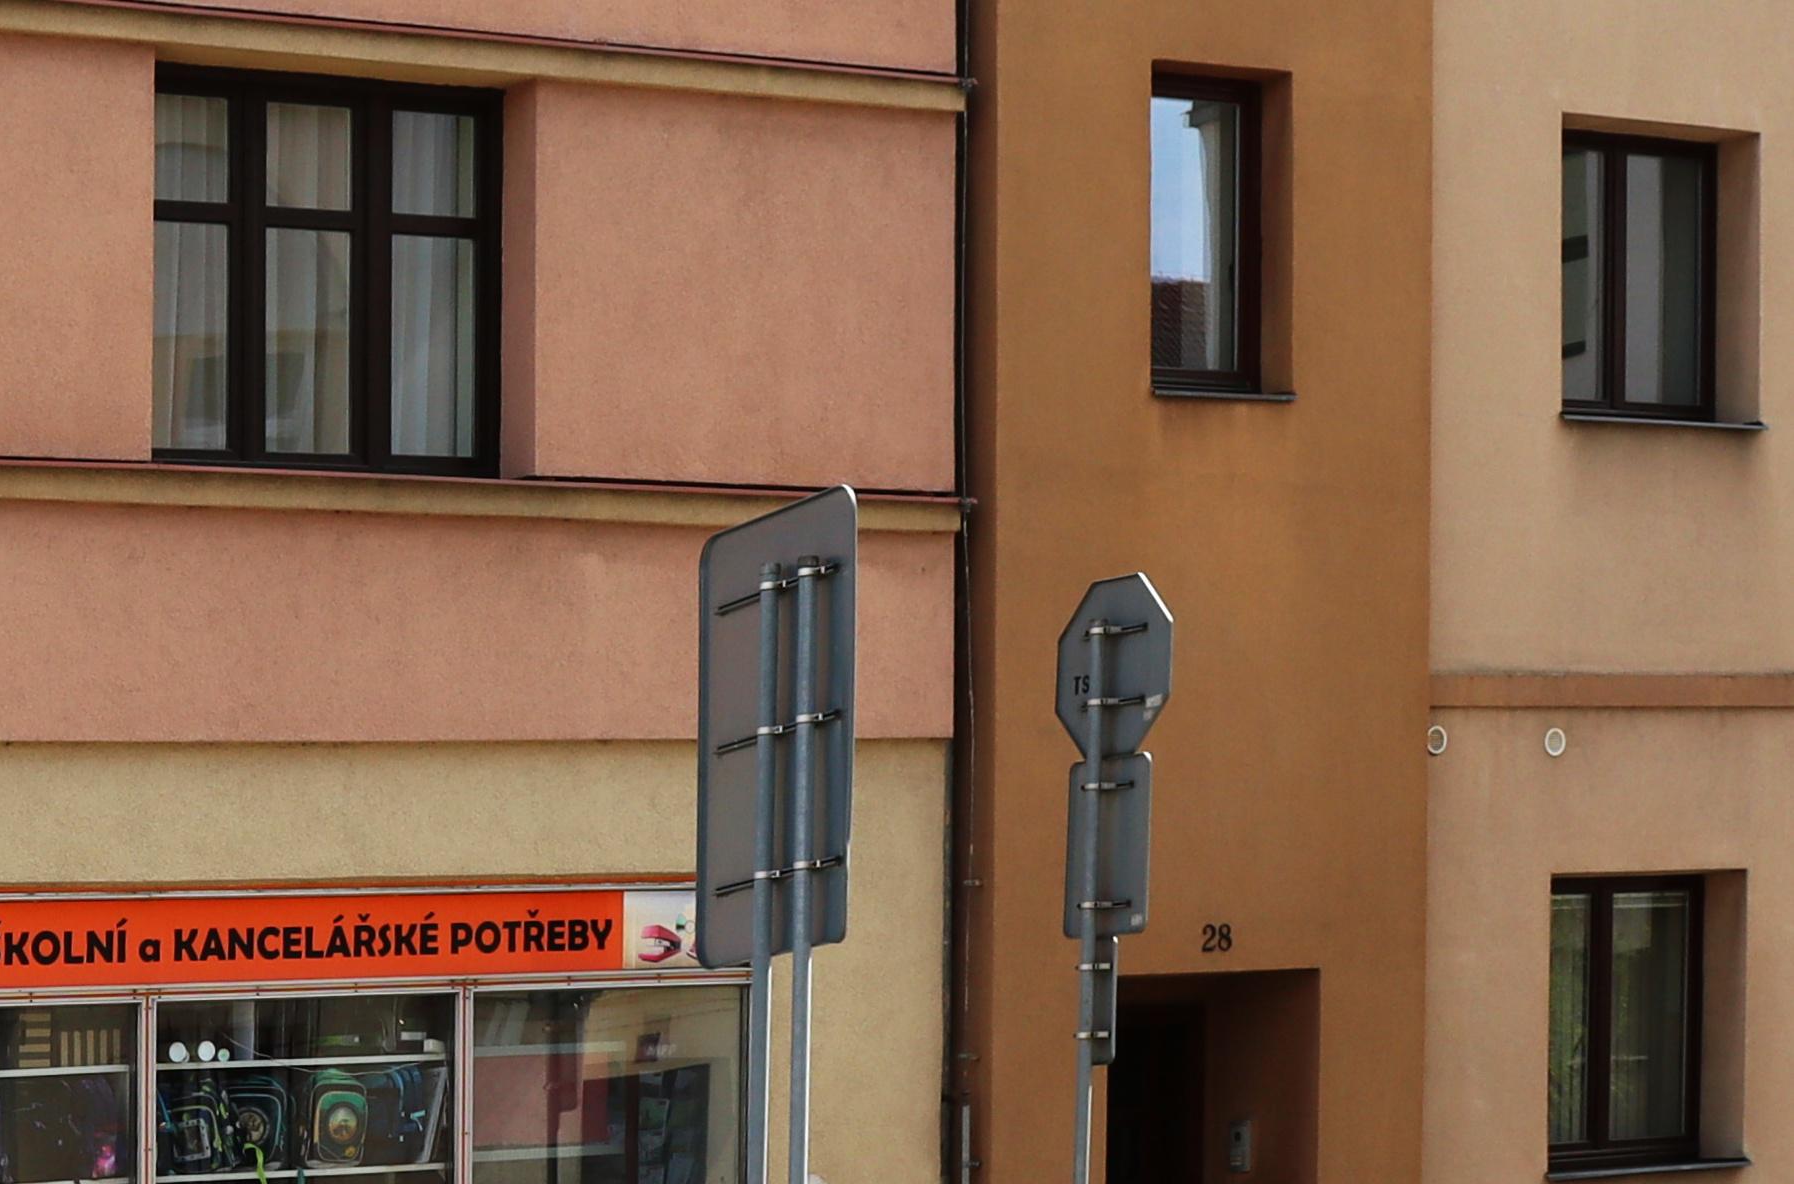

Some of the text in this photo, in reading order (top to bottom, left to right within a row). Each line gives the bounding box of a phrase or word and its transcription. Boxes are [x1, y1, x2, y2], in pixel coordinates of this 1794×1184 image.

[138, 938, 162, 963] a
[172, 911, 440, 962] KANCELÁŘSKÉ
[449, 909, 613, 956] POTŘEBY
[1201, 923, 1233, 953] 28
